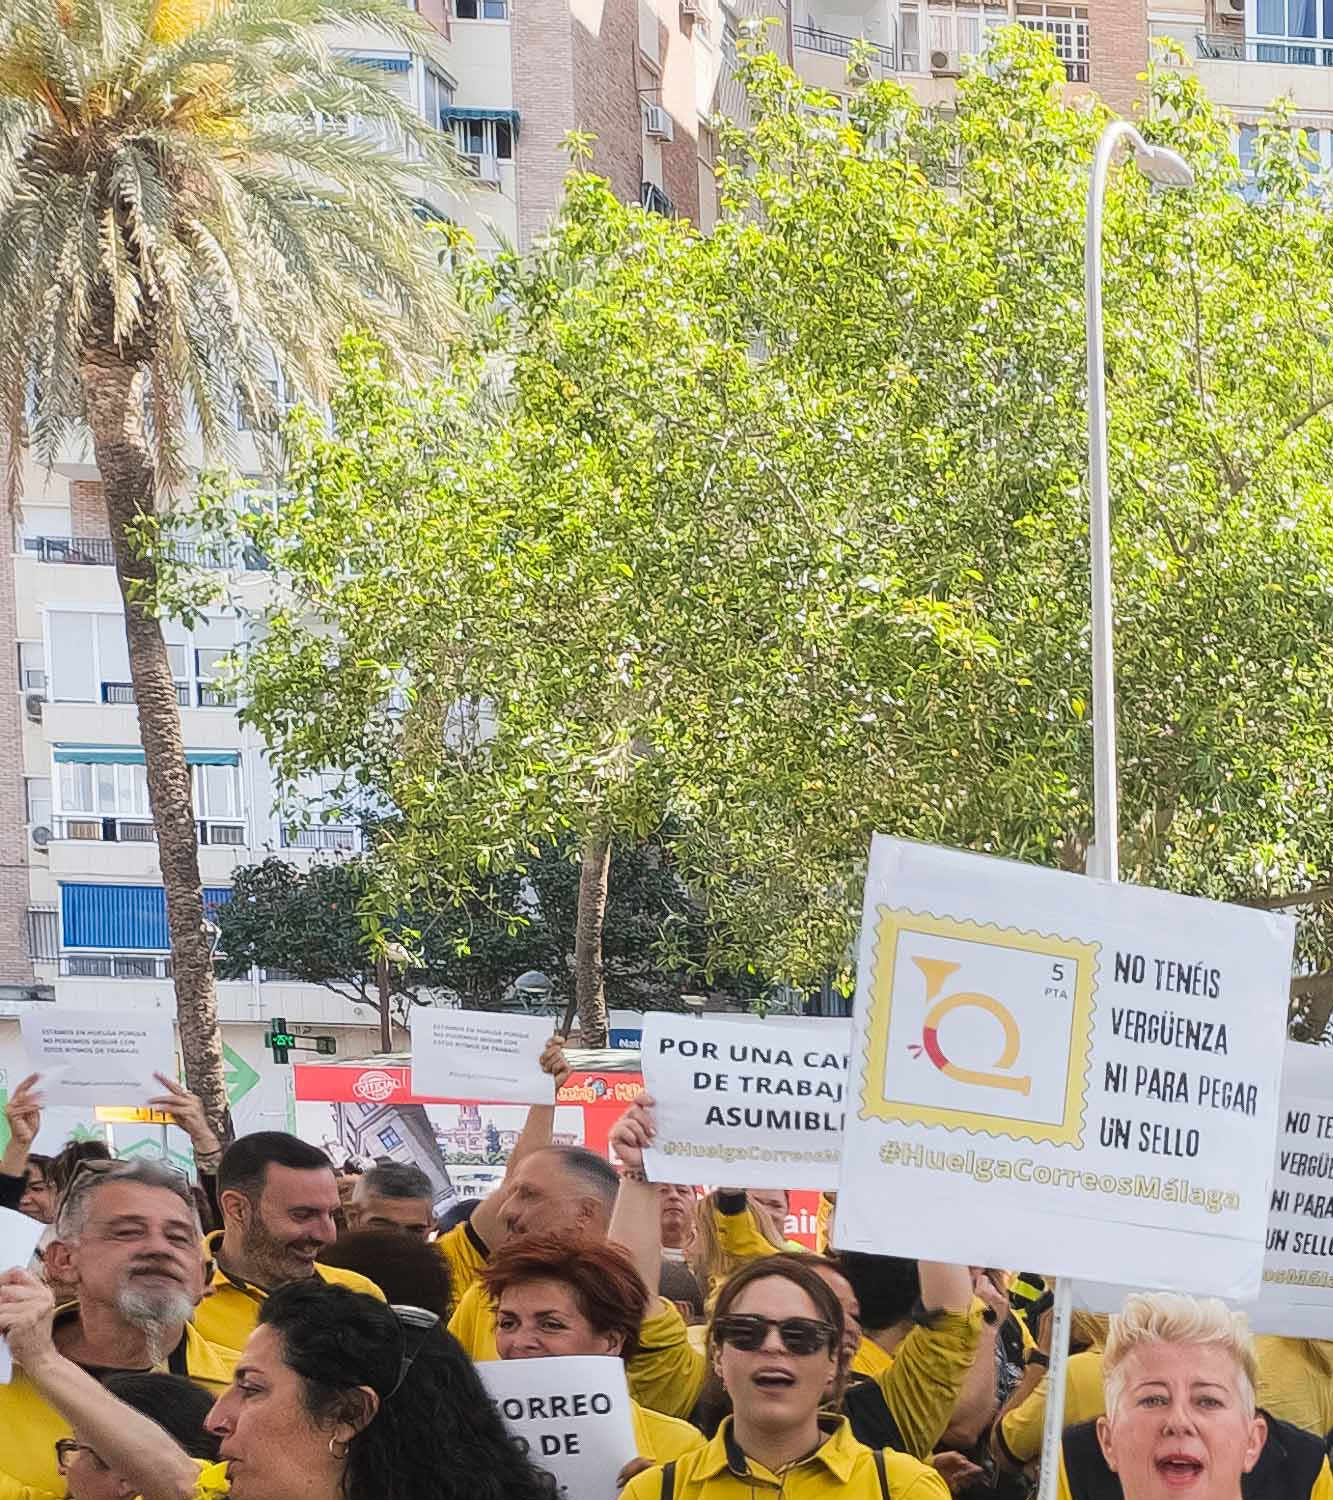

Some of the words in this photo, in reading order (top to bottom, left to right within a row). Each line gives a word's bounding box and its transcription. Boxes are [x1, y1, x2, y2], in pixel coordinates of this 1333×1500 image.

[1051, 963, 1064, 982] 5
[1114, 951, 1146, 984] NO
[1155, 959, 1221, 999] TENÉIS
[1044, 986, 1068, 1001] PTA
[1112, 1007, 1228, 1055] VERGÜENZA
[659, 1038, 719, 1060] POR
[731, 1046, 792, 1066] UNA
[694, 1072, 728, 1092] DE
[739, 1076, 846, 1103] TRABAJ
[1104, 1061, 1127, 1094] NI
[1135, 1065, 1189, 1104] PARA
[1199, 1074, 1258, 1117] PEGAR
[1285, 1110, 1311, 1134] NO
[1100, 1116, 1130, 1151] UN
[1138, 1123, 1200, 1158] SELLO
[878, 1140, 1241, 1213] #HuelgaCorreosMálaga
[1270, 1189, 1290, 1212] NI
[1265, 1227, 1290, 1251] UN
[495, 1392, 612, 1421] ORREO
[540, 1433, 581, 1457] DE
